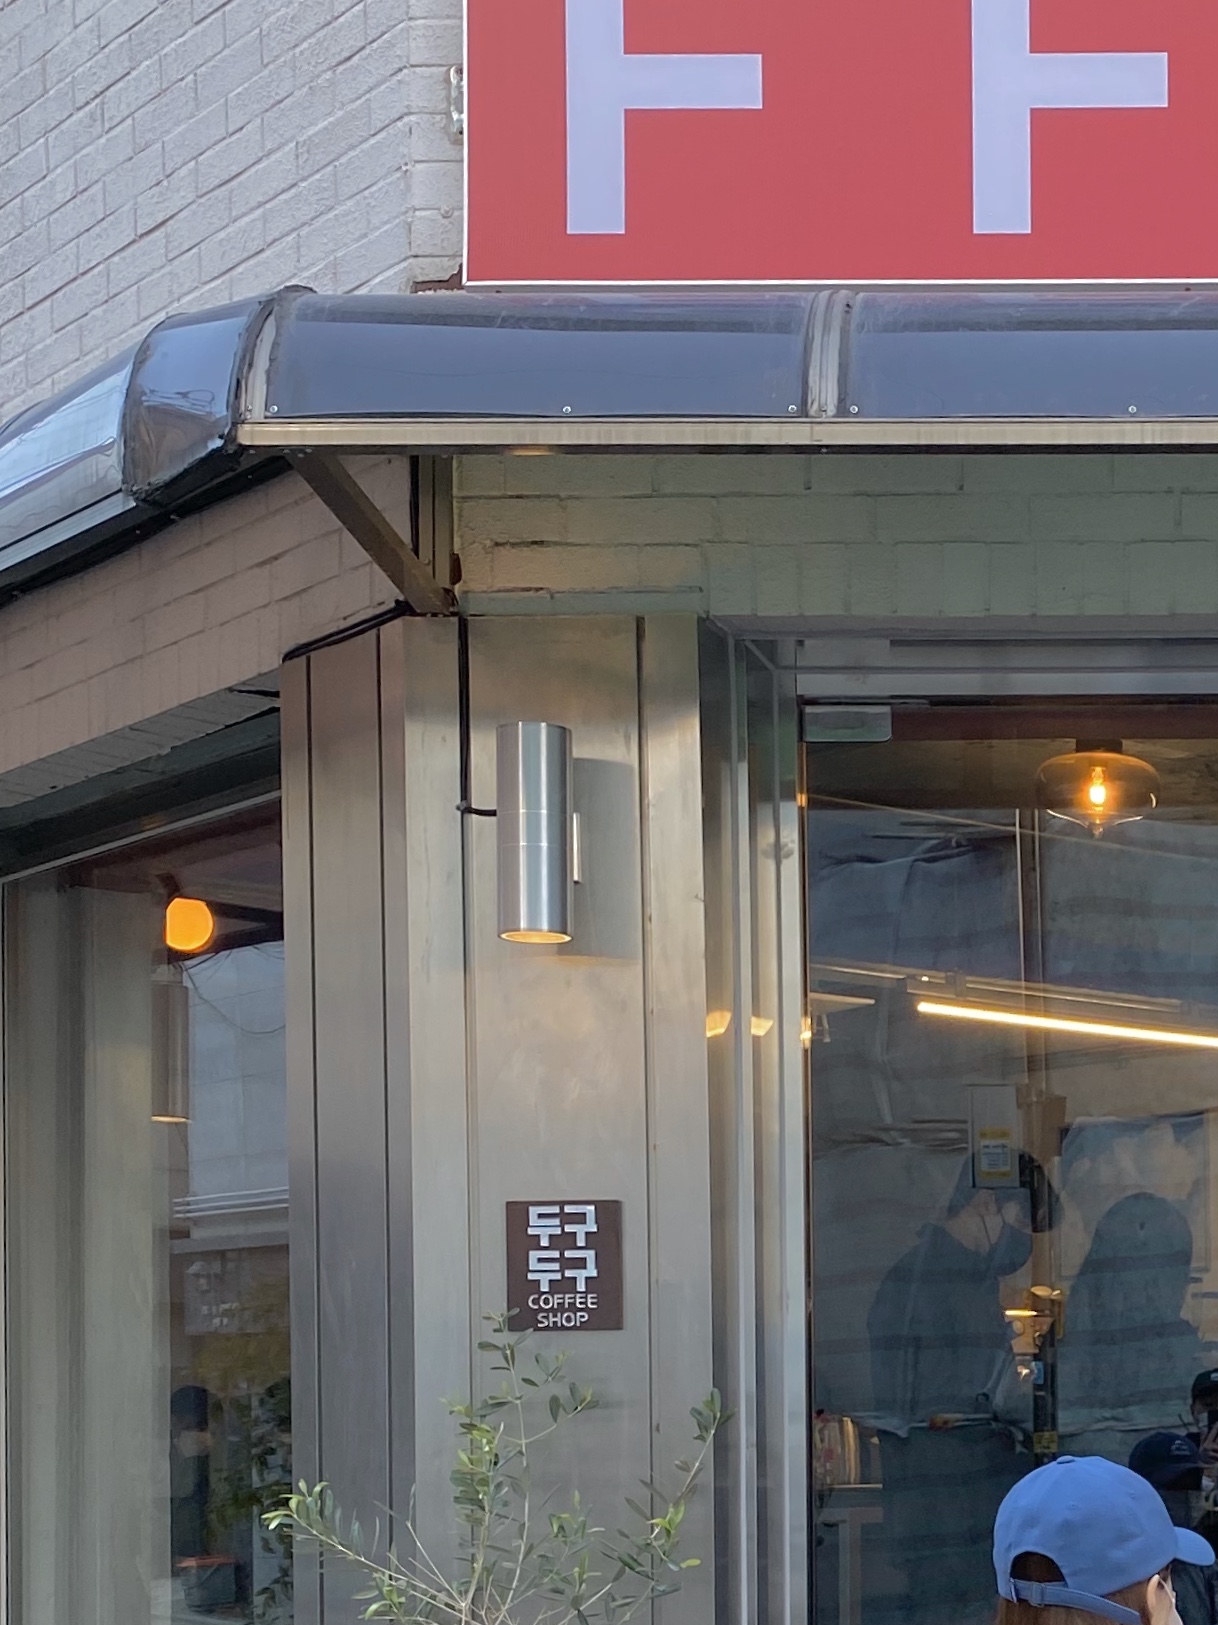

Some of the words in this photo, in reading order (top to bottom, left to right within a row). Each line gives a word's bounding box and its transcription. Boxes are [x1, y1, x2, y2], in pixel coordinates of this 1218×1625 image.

[527, 1204, 598, 1247] 두구
[527, 1249, 598, 1292] 두구
[528, 1293, 598, 1309] COFFEE
[537, 1312, 589, 1328] SHOP
